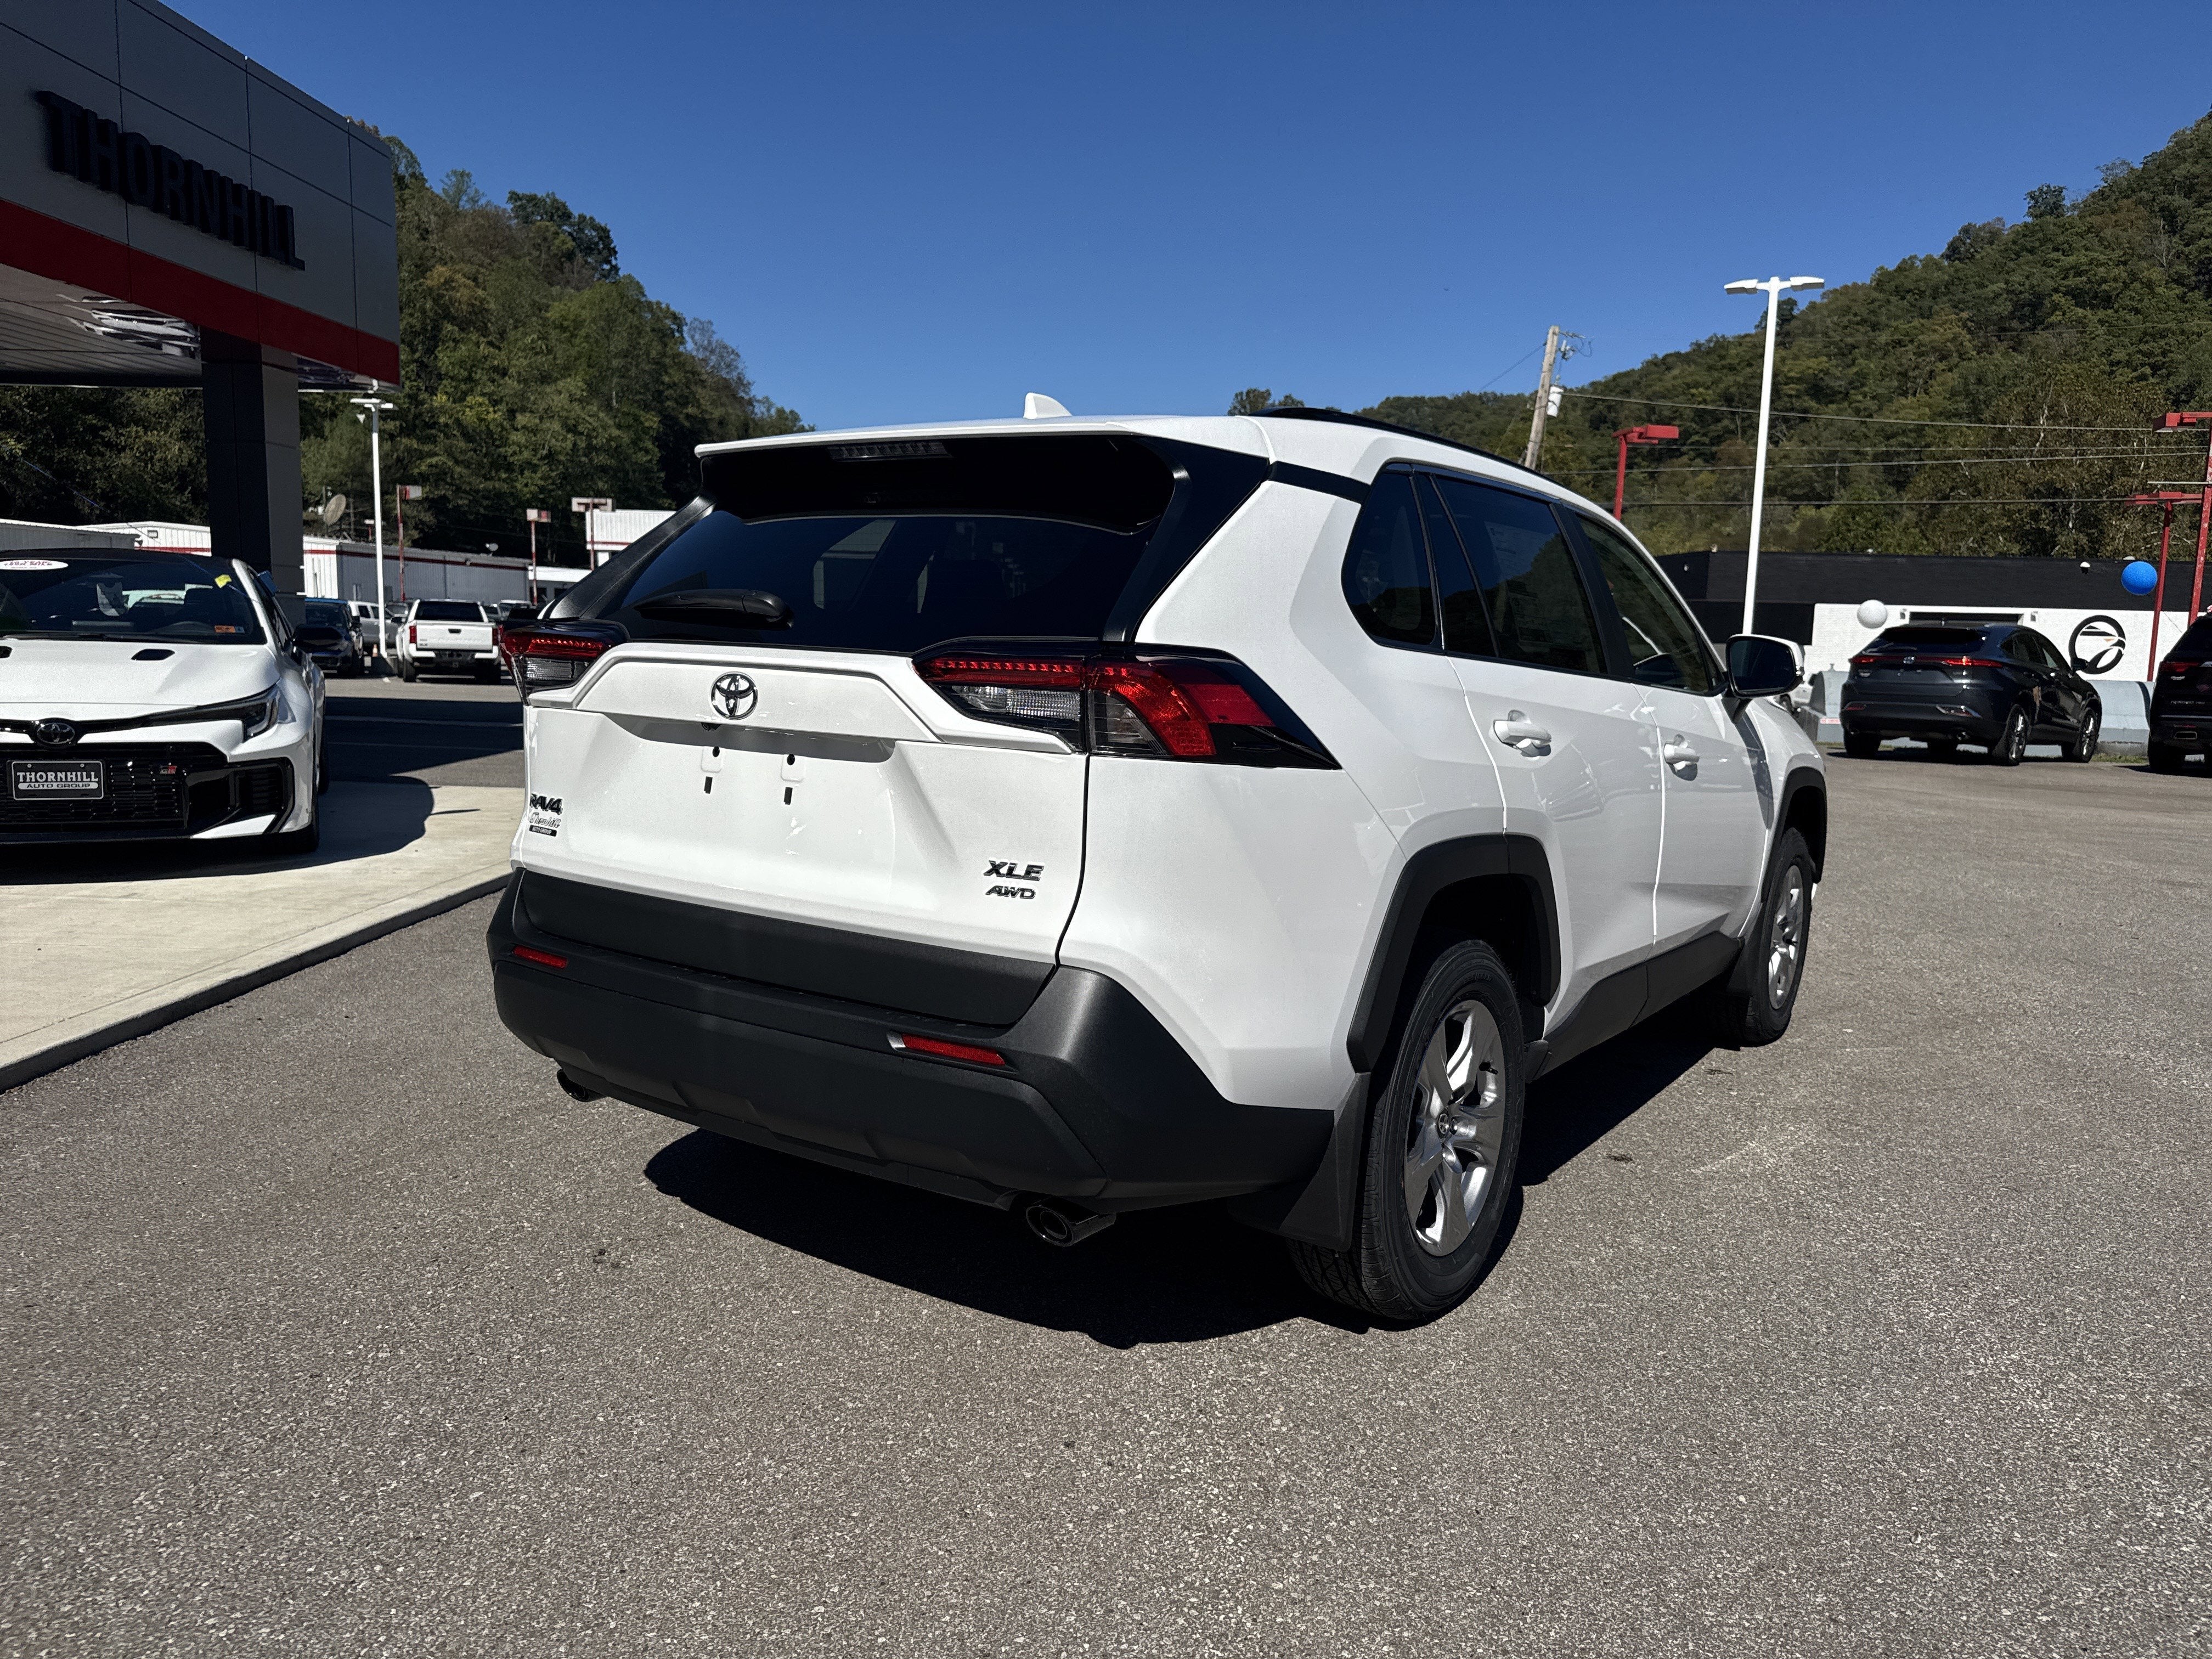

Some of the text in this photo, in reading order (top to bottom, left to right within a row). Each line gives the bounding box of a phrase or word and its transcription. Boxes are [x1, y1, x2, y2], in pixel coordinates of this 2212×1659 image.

[35, 91, 305, 270] THORNHILL
[16, 771, 99, 782] THORNHILL
[529, 793, 563, 815] RAV4
[984, 860, 1045, 881] XLE
[985, 885, 1036, 899] AWD
